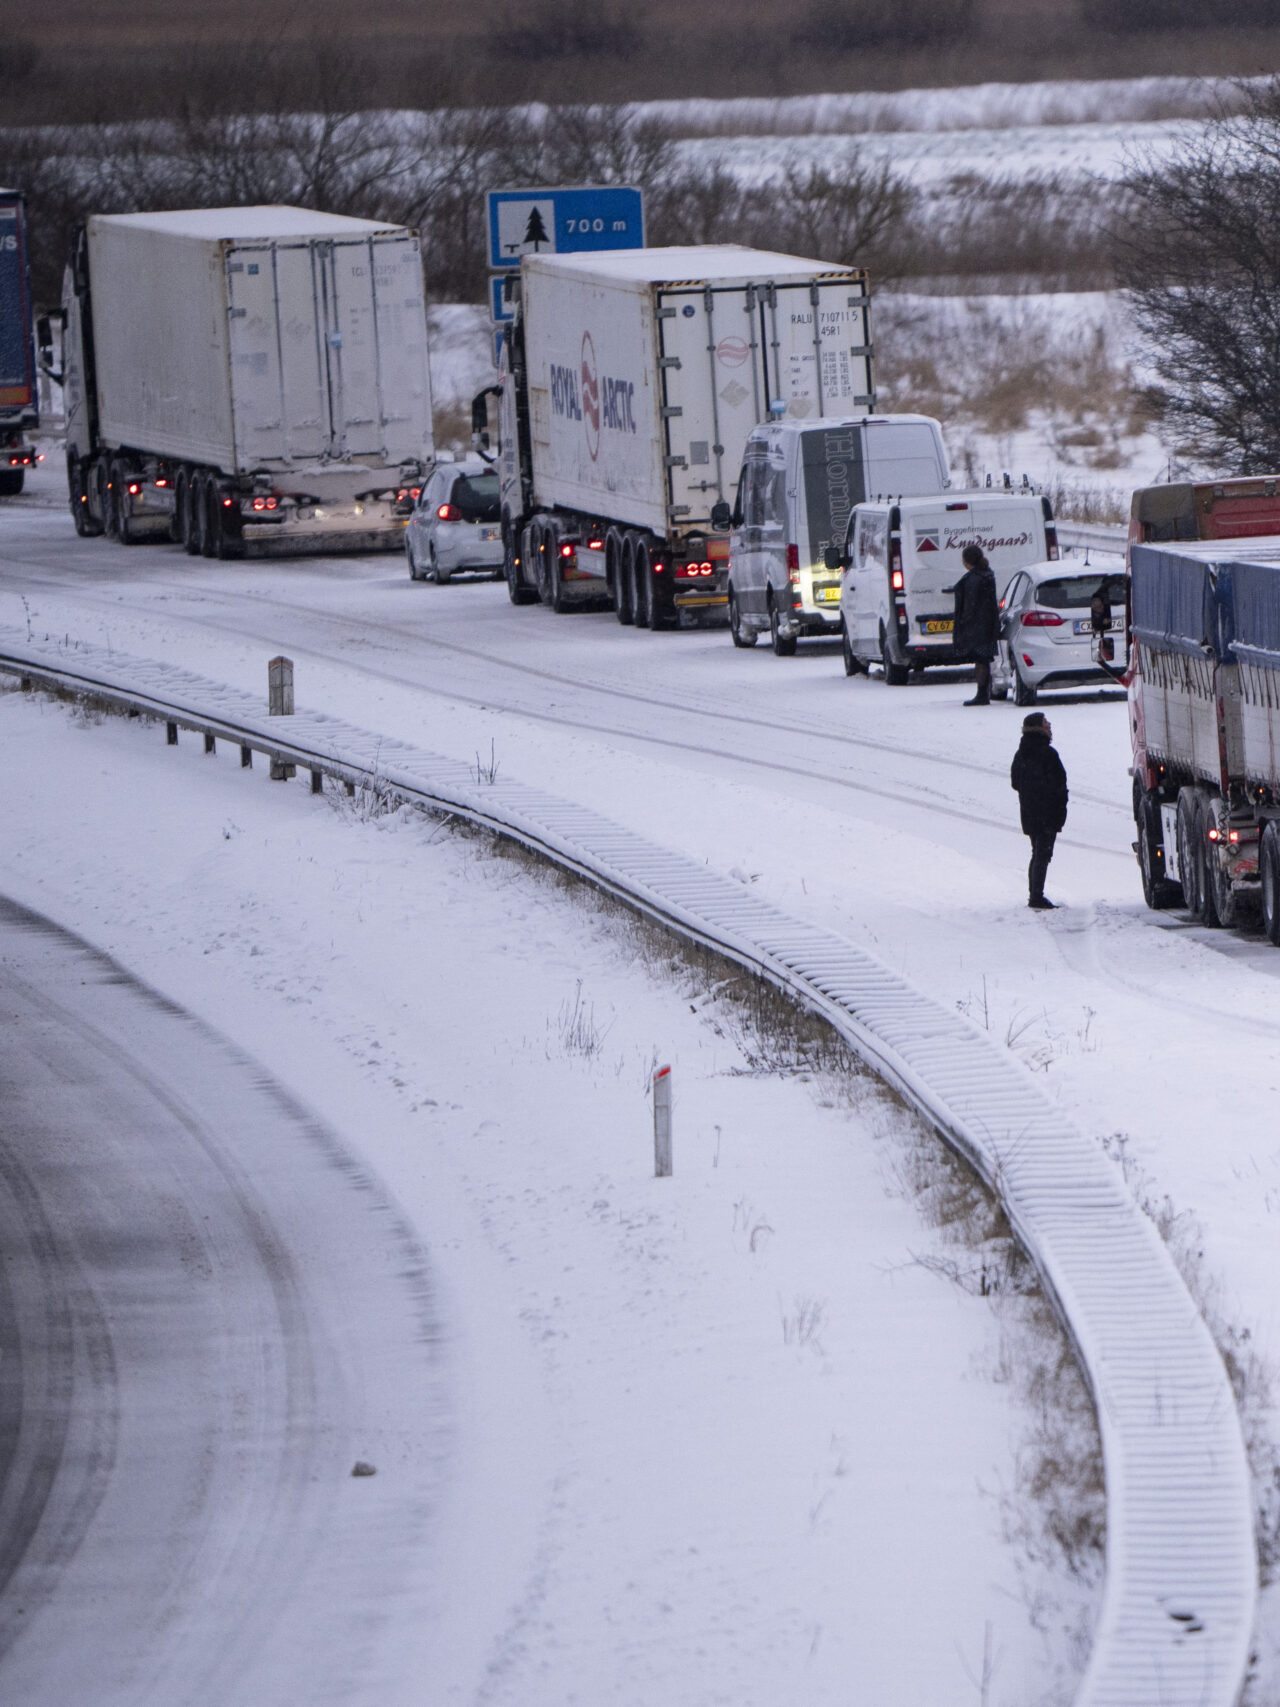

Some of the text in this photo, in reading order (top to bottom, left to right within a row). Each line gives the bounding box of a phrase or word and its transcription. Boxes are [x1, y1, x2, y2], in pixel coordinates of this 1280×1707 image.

[566, 218, 626, 233] 700 m
[791, 313, 813, 324] RALU
[550, 363, 636, 434] ROYAL ARCTIC
[944, 532, 1028, 552] Knudsgaard
